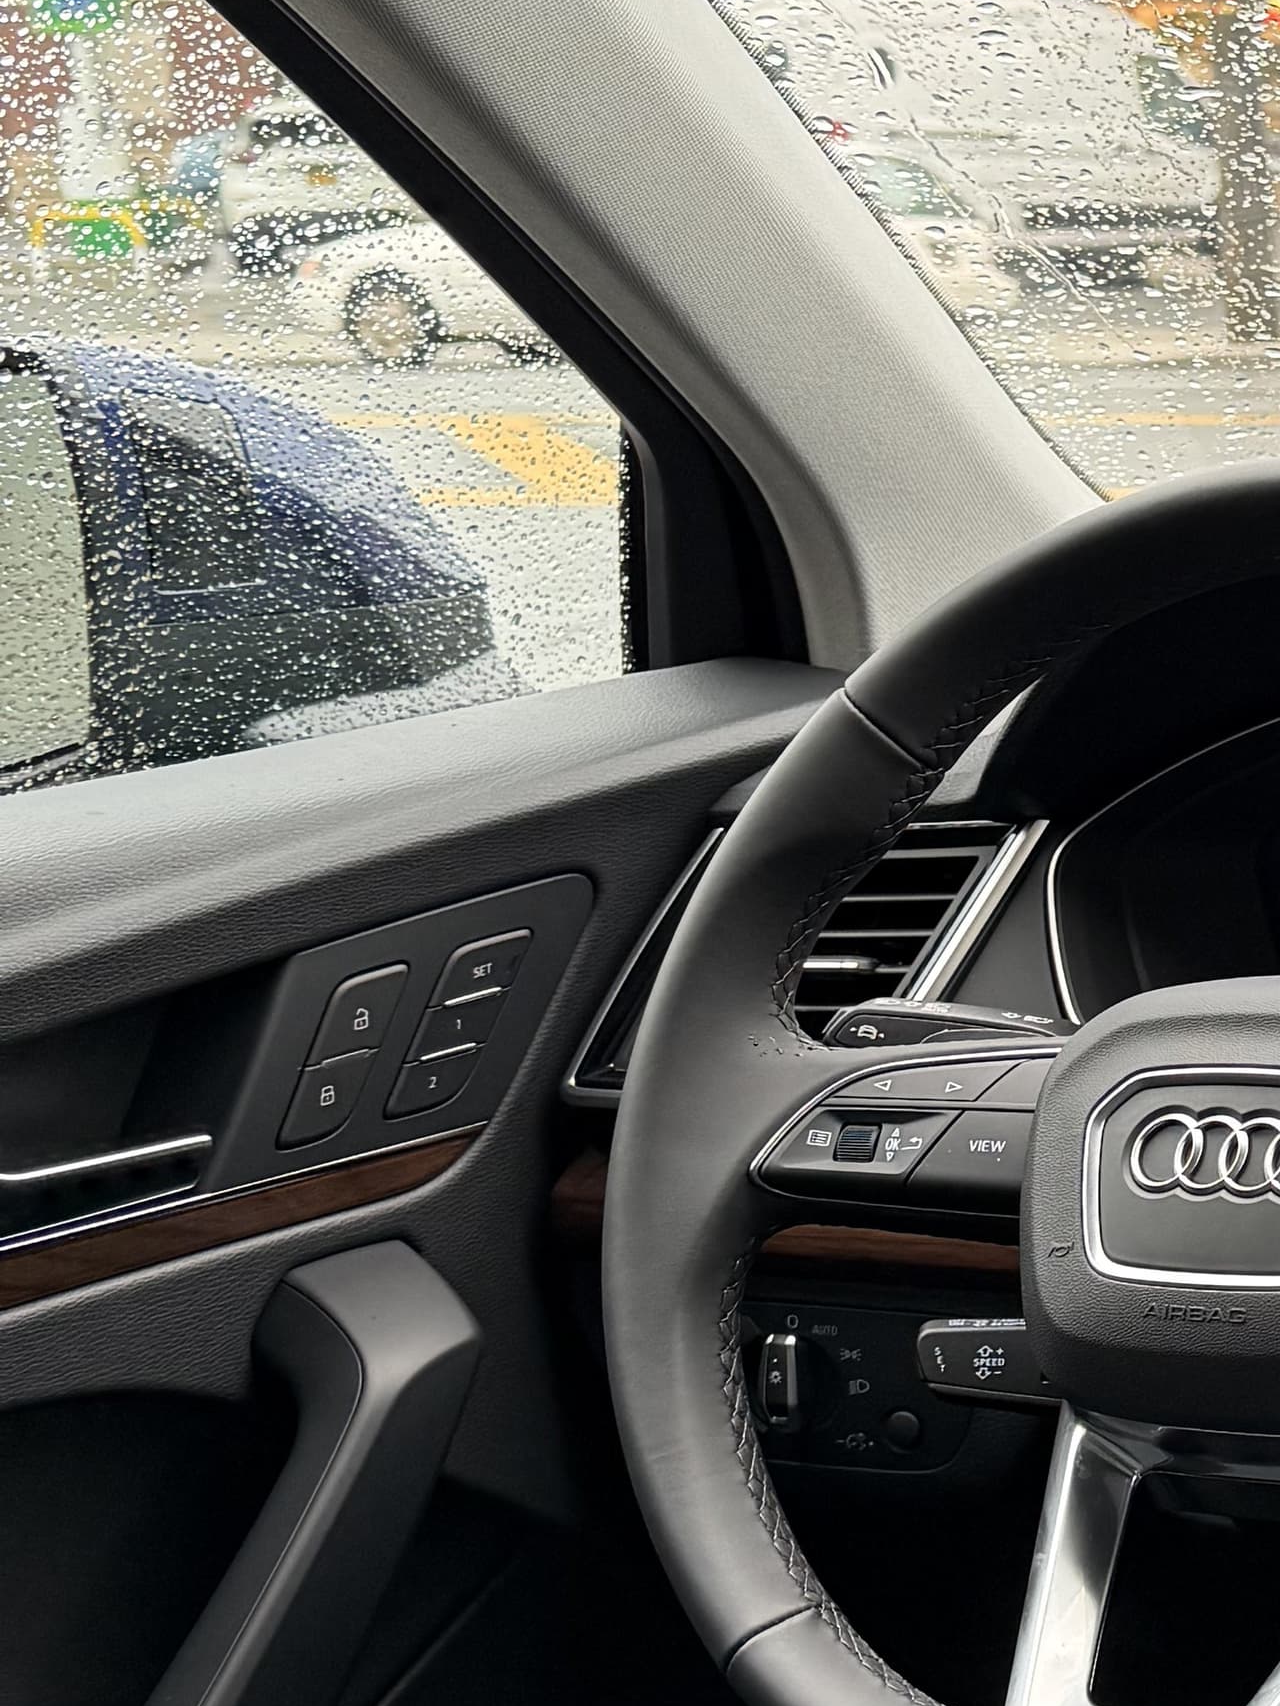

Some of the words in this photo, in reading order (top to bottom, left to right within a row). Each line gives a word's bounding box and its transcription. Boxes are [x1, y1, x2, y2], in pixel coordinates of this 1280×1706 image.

[473, 962, 492, 979] SET
[455, 1018, 462, 1031] 1
[428, 1076, 437, 1090] 2
[884, 1137, 901, 1152] OK
[969, 1139, 1006, 1153] VIEW
[1143, 1301, 1248, 1324] AIRBAG
[973, 1357, 1006, 1368] SPEED
